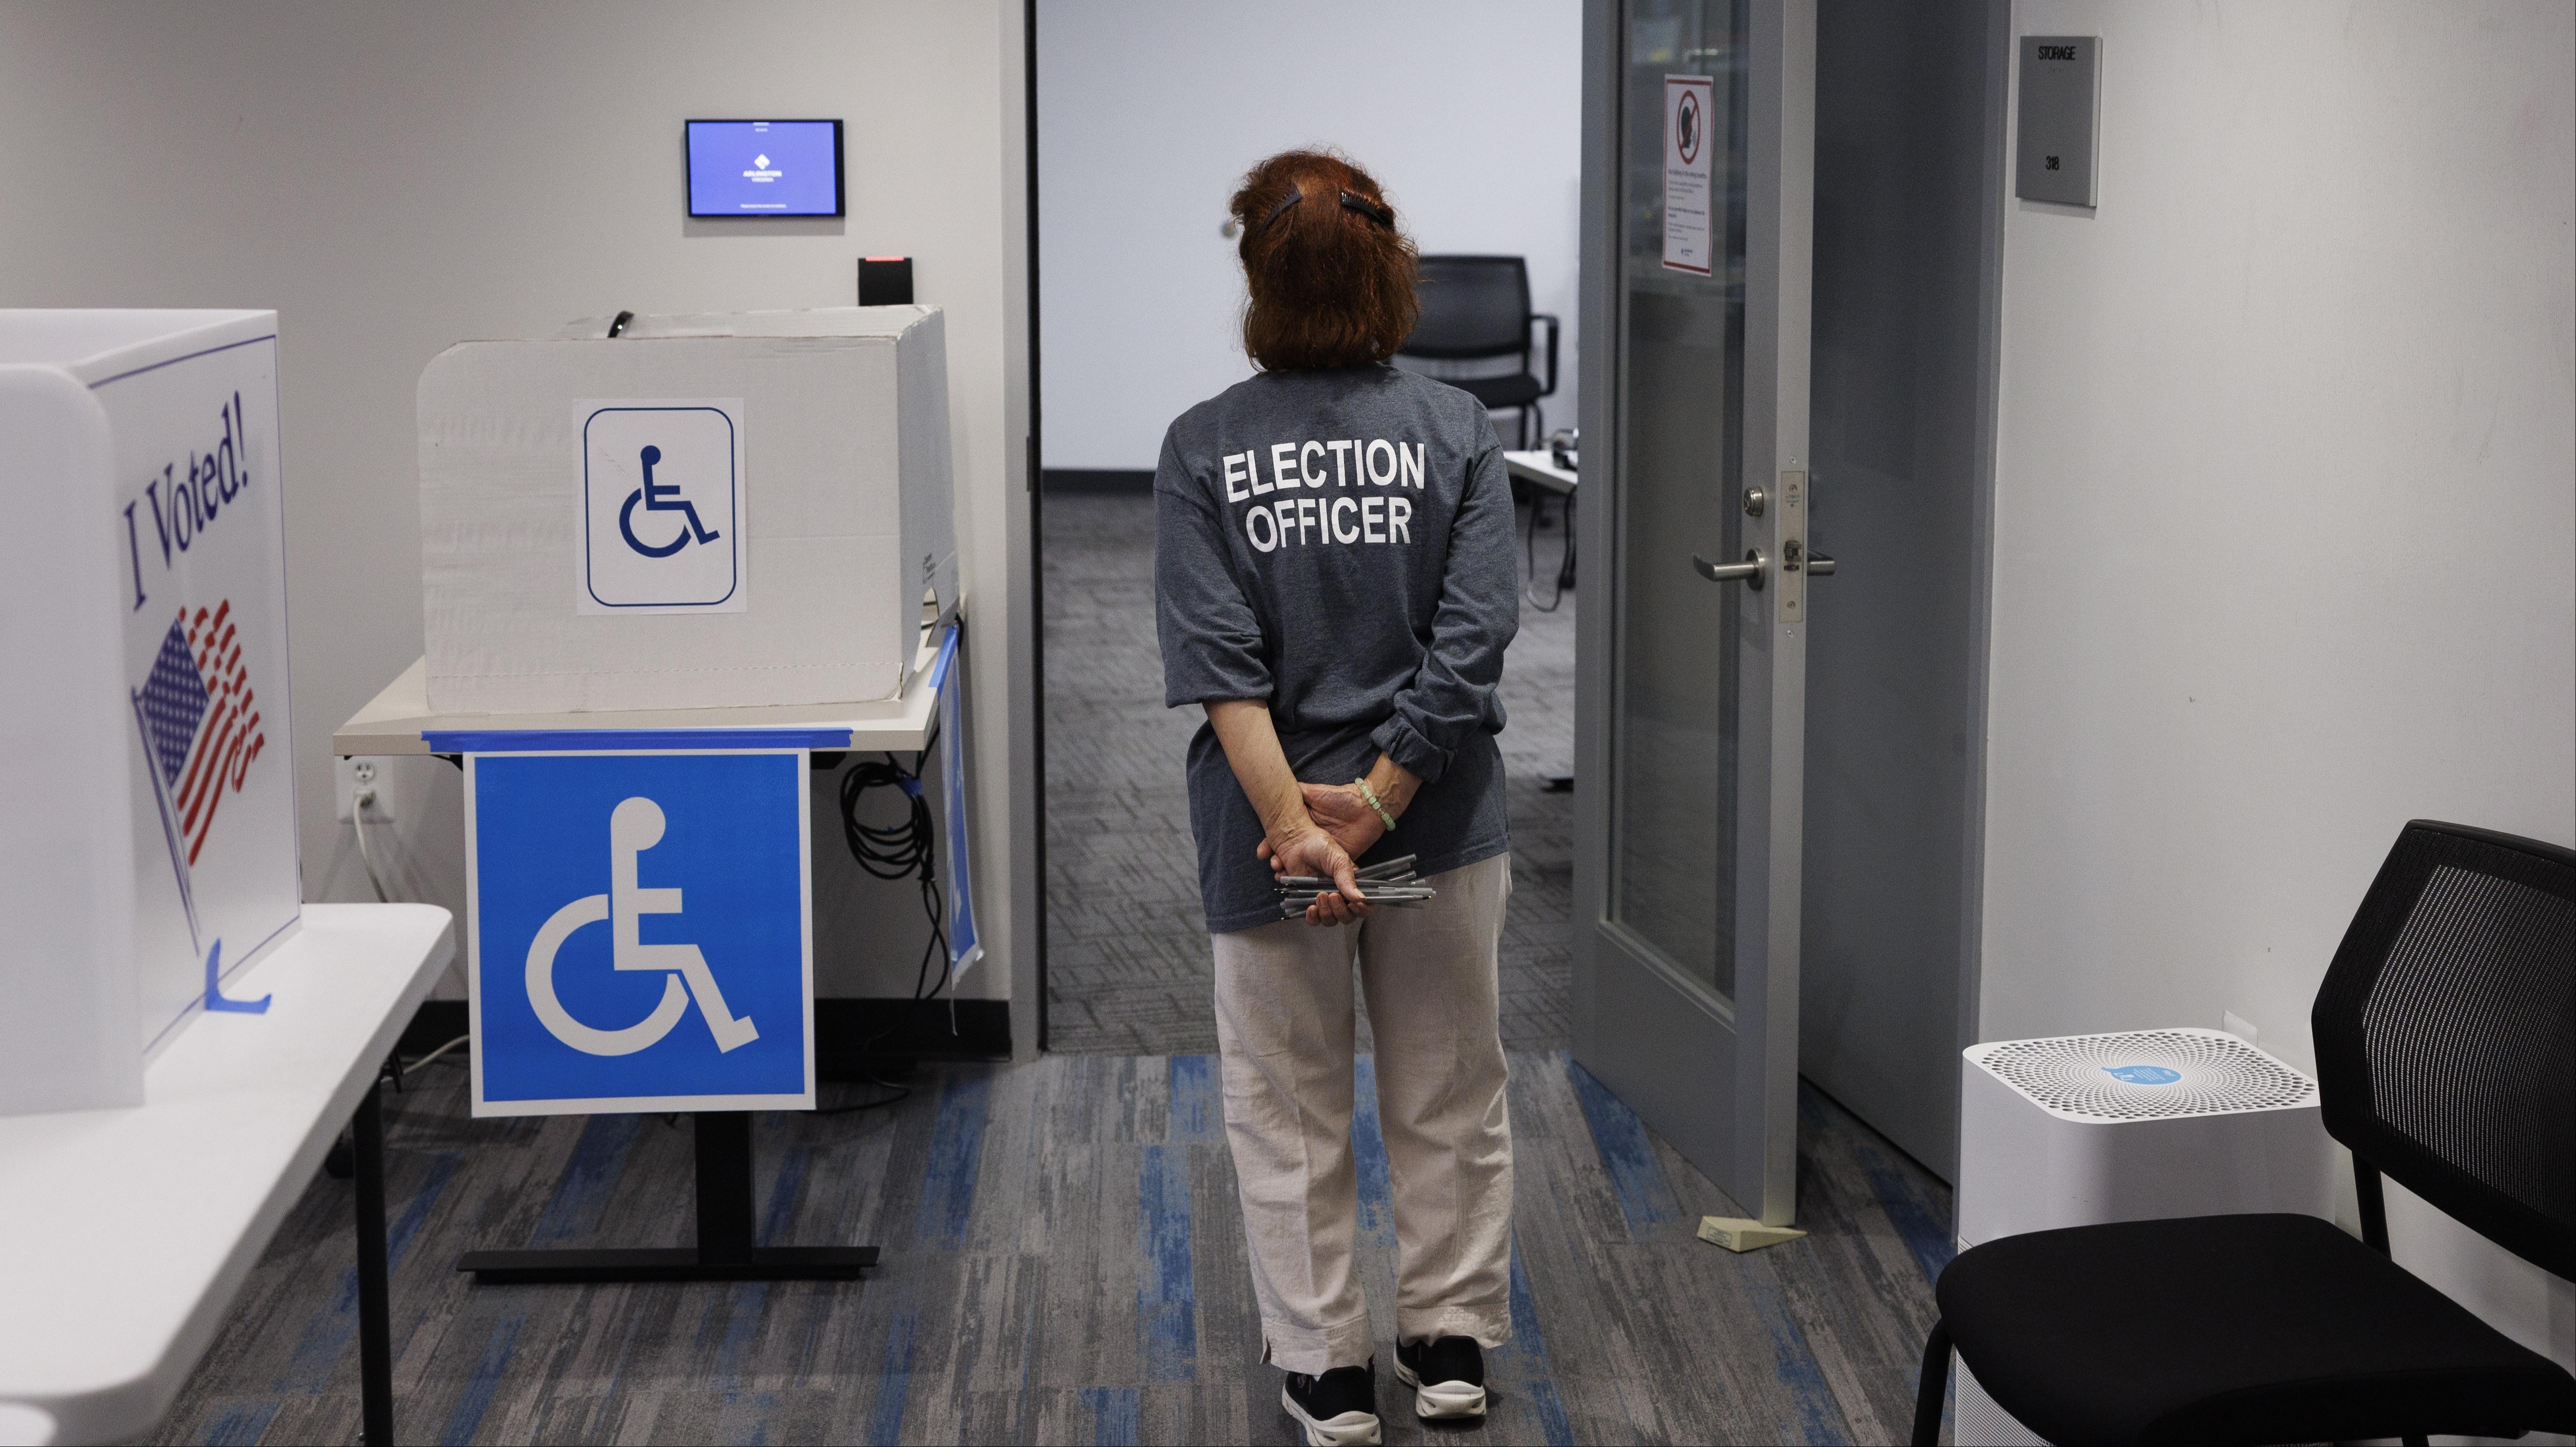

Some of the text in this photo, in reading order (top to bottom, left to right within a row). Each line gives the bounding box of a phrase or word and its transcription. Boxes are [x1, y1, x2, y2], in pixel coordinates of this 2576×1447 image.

[2038, 45, 2076, 60] STORAGE
[2045, 155, 2059, 170] 318
[1223, 438, 1425, 503] ELECTION
[123, 391, 248, 612] I Voted!
[1246, 497, 1412, 552] OFFICER
